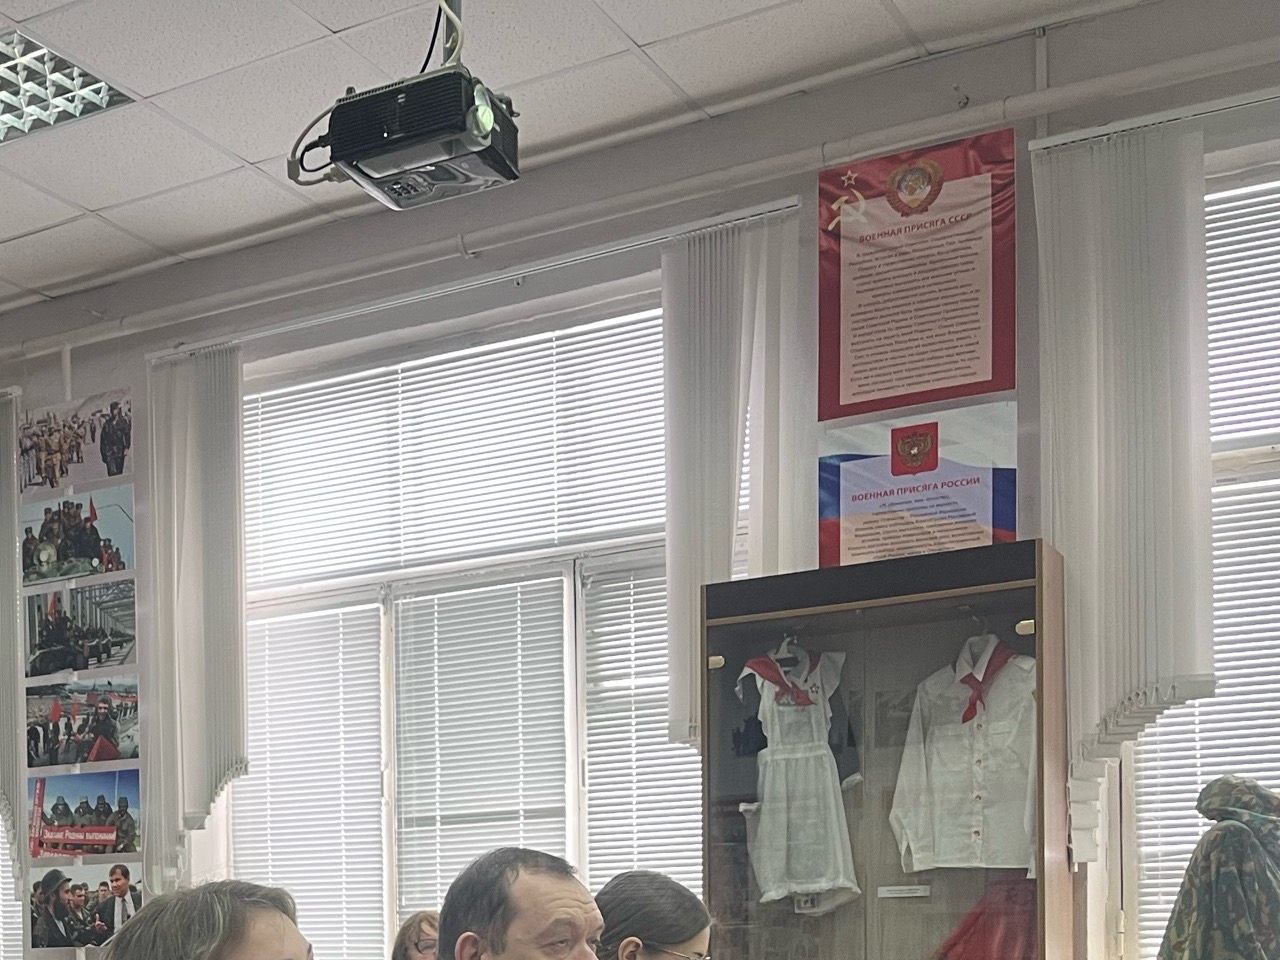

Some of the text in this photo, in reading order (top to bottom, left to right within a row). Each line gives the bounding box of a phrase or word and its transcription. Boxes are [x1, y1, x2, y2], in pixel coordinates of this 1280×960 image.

[859, 212, 973, 243] ВОЕННАЯ ПРИСЯГА СССР
[851, 476, 980, 502] ВОЕННАЯ ПРИСЯГА РОССИИ
